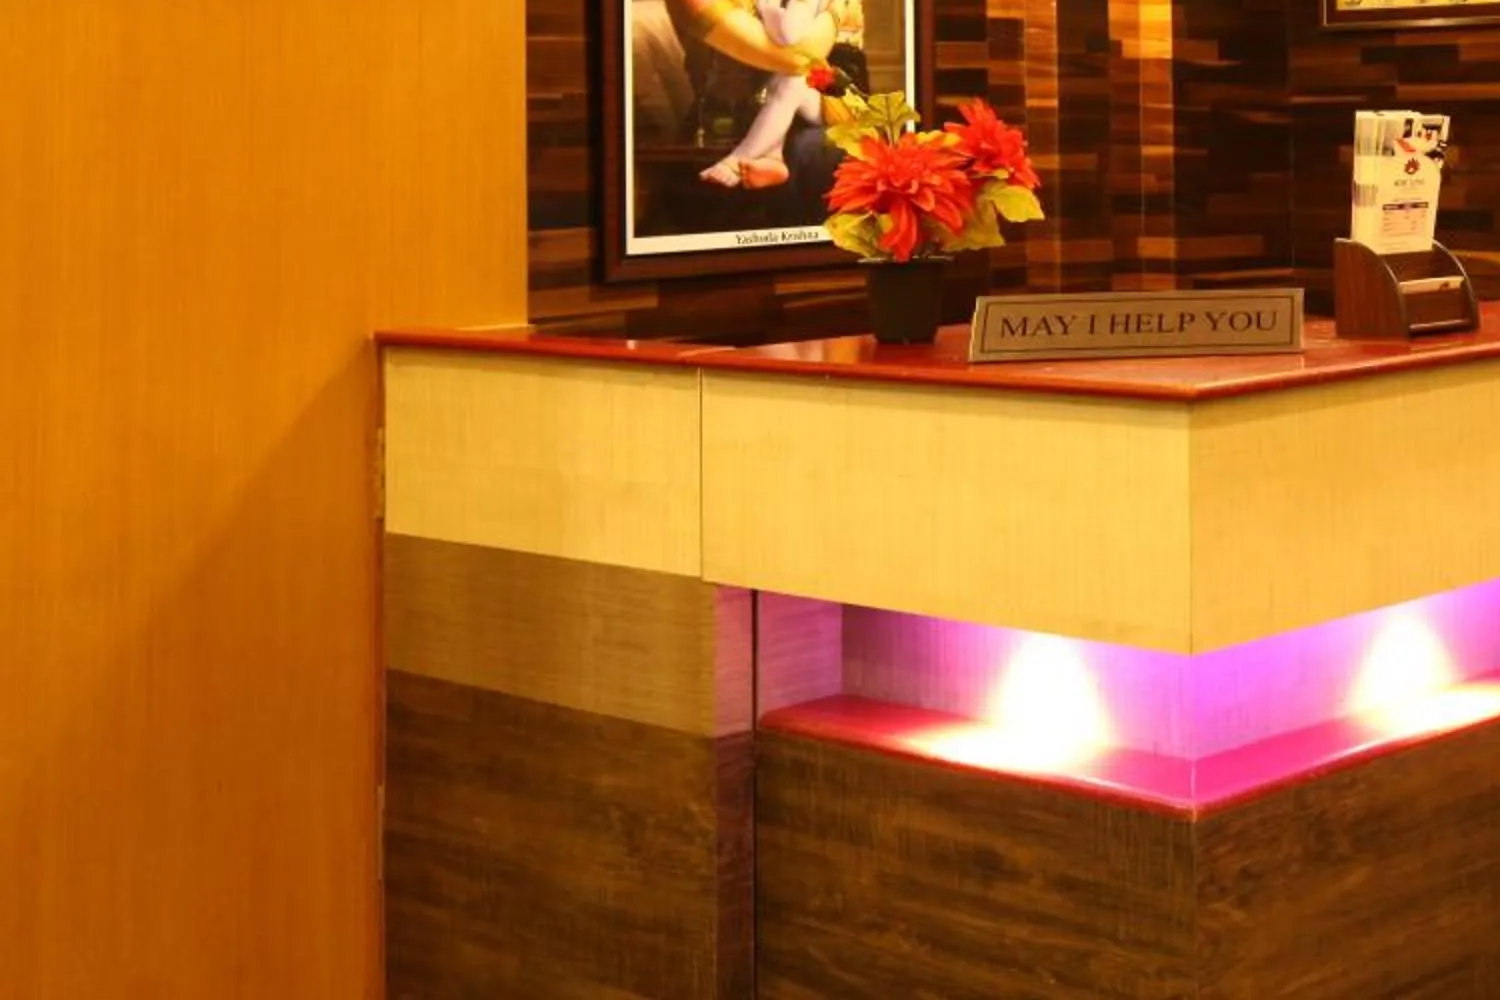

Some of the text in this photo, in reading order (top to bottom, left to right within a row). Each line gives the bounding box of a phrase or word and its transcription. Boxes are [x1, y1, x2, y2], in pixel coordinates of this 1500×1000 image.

[781, 230, 819, 241] Krishna
[1000, 310, 1278, 339] MAY I HELP YOU
